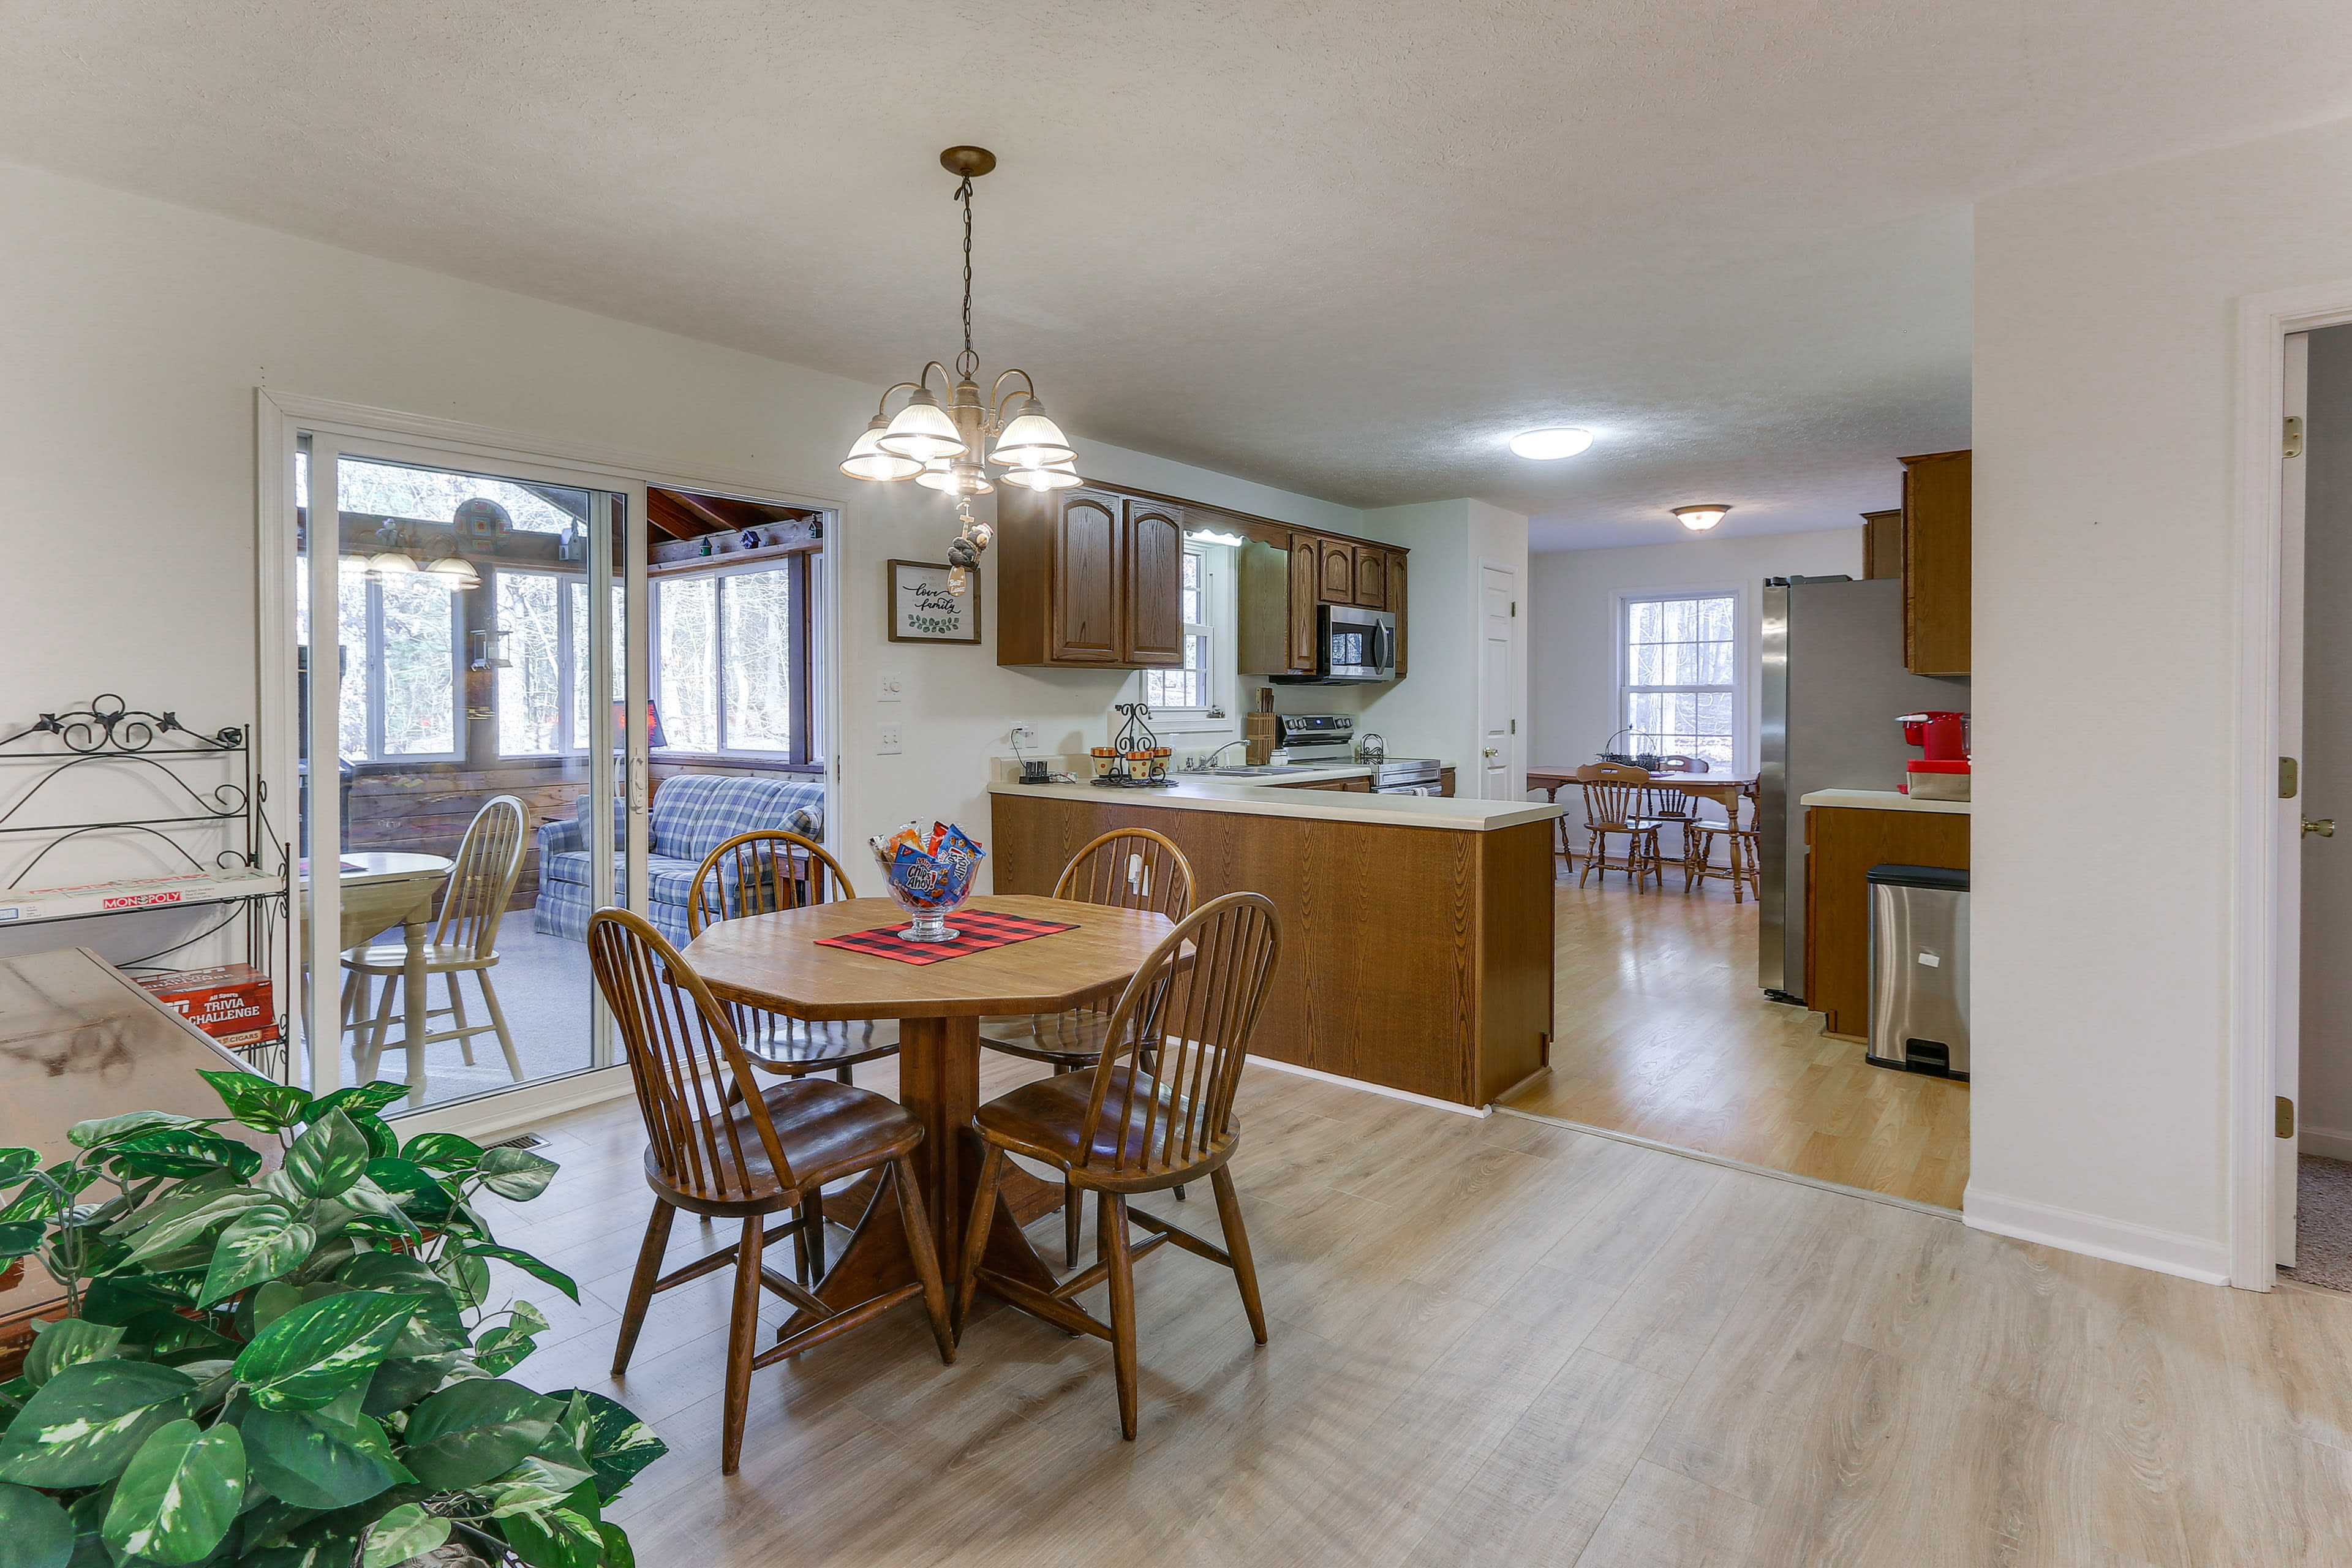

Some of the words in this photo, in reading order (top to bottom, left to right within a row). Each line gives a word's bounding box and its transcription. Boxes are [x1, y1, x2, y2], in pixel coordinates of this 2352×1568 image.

[902, 583, 951, 597] love
[914, 598, 961, 614] family
[917, 858, 931, 870] Mini
[908, 865, 931, 880] Chips
[907, 872, 937, 891] Ahoy!
[104, 892, 180, 909] MONOPOLY
[204, 998, 244, 1012] TRIVIA
[189, 1006, 260, 1025] CHALLENGE
[230, 1033, 258, 1042] CIGARS
